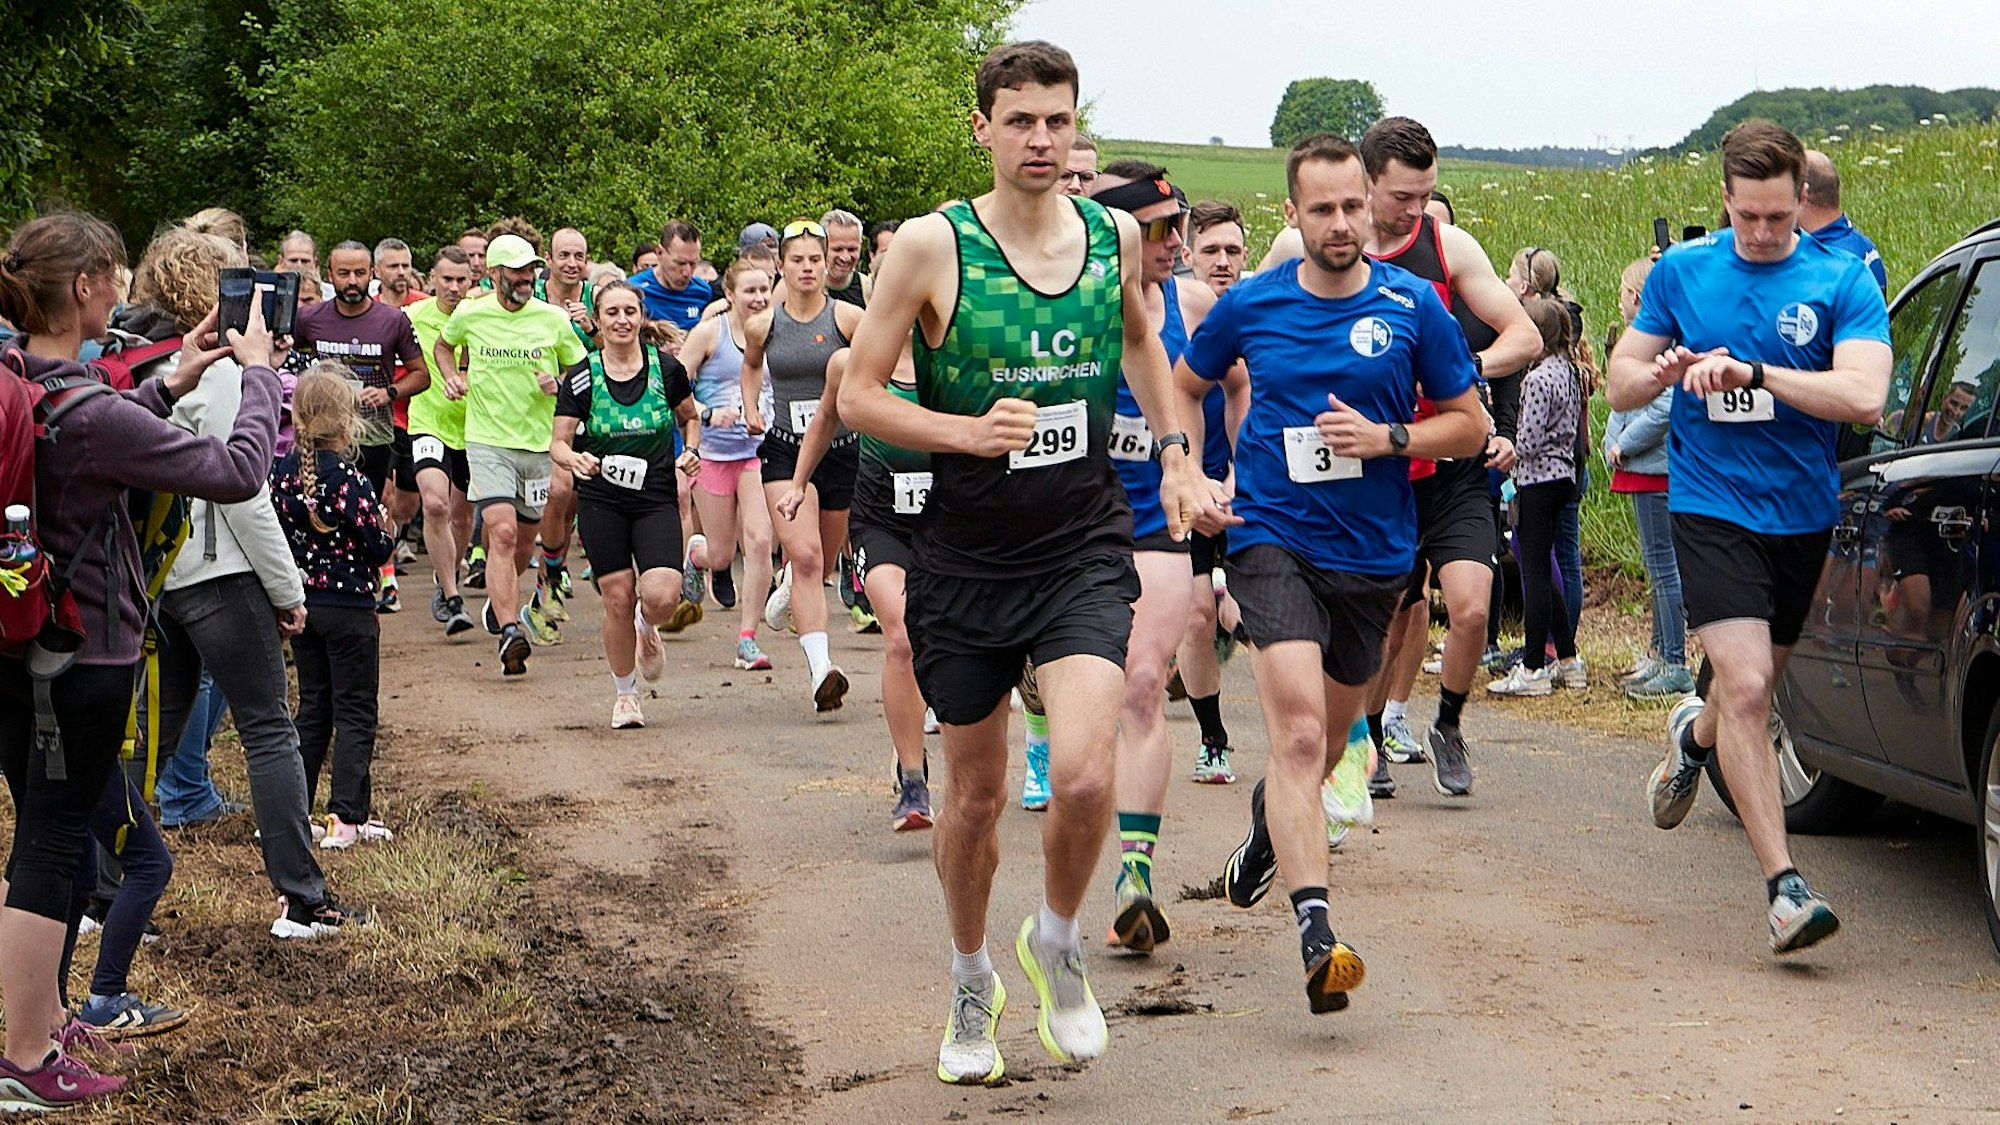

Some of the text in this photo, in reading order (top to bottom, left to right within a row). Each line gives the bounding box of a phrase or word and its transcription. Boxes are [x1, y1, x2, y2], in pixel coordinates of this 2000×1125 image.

[316, 338, 382, 356] IRONMAN
[480, 346, 530, 360] ERDINGER
[1030, 329, 1077, 358] LC
[992, 361, 1101, 382] EUSKIRCHEN
[1723, 388, 1754, 413] 99
[1023, 426, 1077, 458] 299
[1315, 447, 1332, 471] 3
[607, 465, 636, 484] 211
